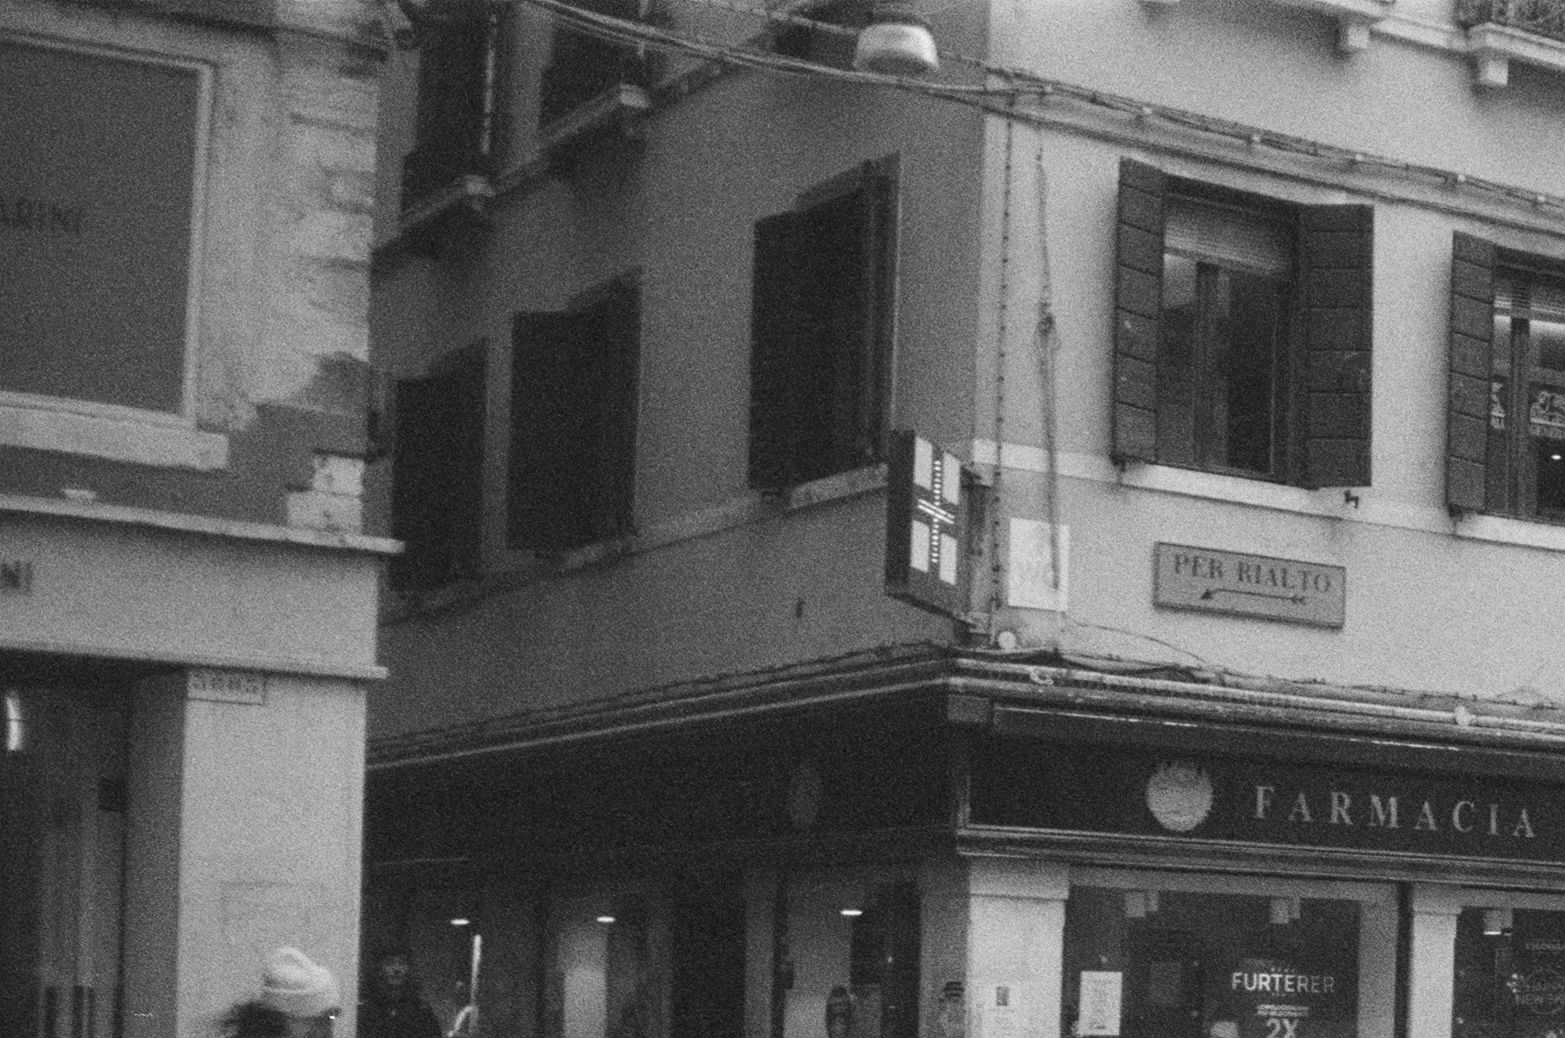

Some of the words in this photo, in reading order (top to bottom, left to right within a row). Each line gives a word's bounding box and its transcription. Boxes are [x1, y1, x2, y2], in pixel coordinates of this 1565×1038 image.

[1174, 553, 1224, 580] PER
[1237, 561, 1332, 592] RIALTO
[1253, 785, 1536, 839] FARMACIA
[1231, 972, 1335, 993] FURTERER
